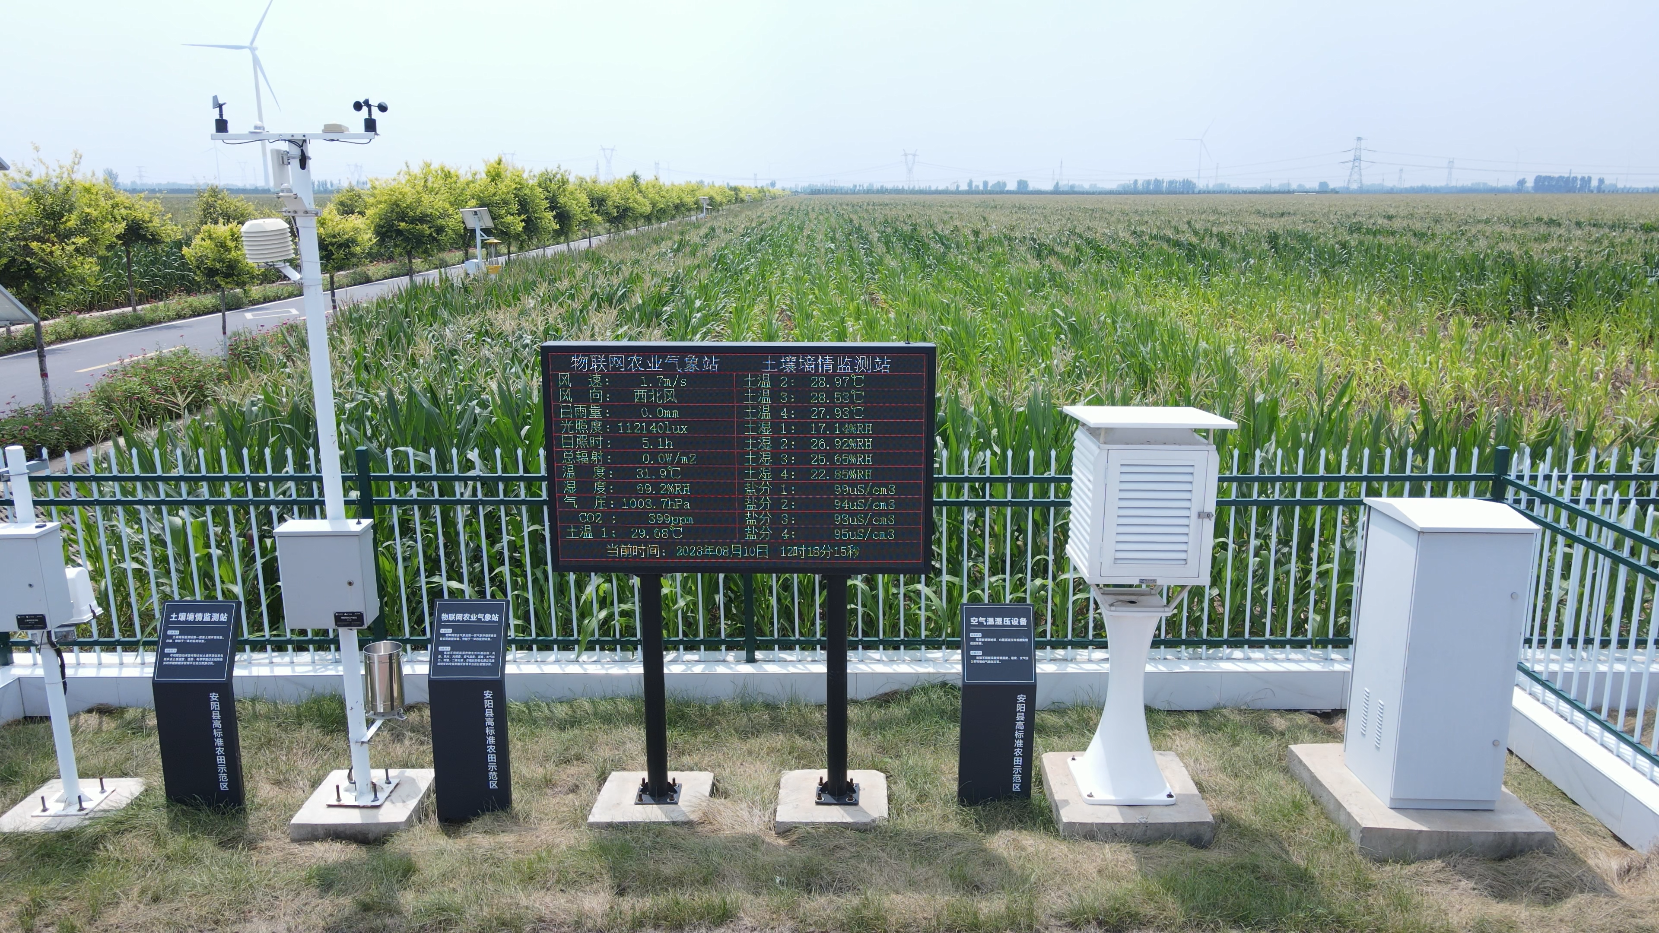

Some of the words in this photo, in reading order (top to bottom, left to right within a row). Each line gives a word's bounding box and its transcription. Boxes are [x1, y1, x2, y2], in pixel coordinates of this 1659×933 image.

[570, 354, 720, 372] 物联网农业气象站
[762, 355, 891, 373] 土壤墒情监测站
[634, 389, 678, 403] 西北风
[560, 404, 609, 419] 日雨量:
[641, 408, 679, 418] 0.0mm
[561, 419, 610, 434] 光照度:
[618, 422, 688, 434] 112140lux
[562, 435, 611, 449] 日照时:
[642, 437, 673, 449] 5.1h
[811, 439, 872, 450] 26.92%RH
[562, 451, 611, 463] 总辐射:
[622, 498, 691, 509] 1003.7hPa
[170, 613, 228, 621] 土壤墒情监测站
[441, 613, 499, 621] 物联网农业气象站
[970, 617, 1027, 625] 空气温湿压设备
[209, 693, 229, 790] 安阳县高标准农田示范区
[484, 690, 498, 789] 安阳县高标准农田示范区
[1012, 694, 1026, 792] 安阳县高标准农田示范区
